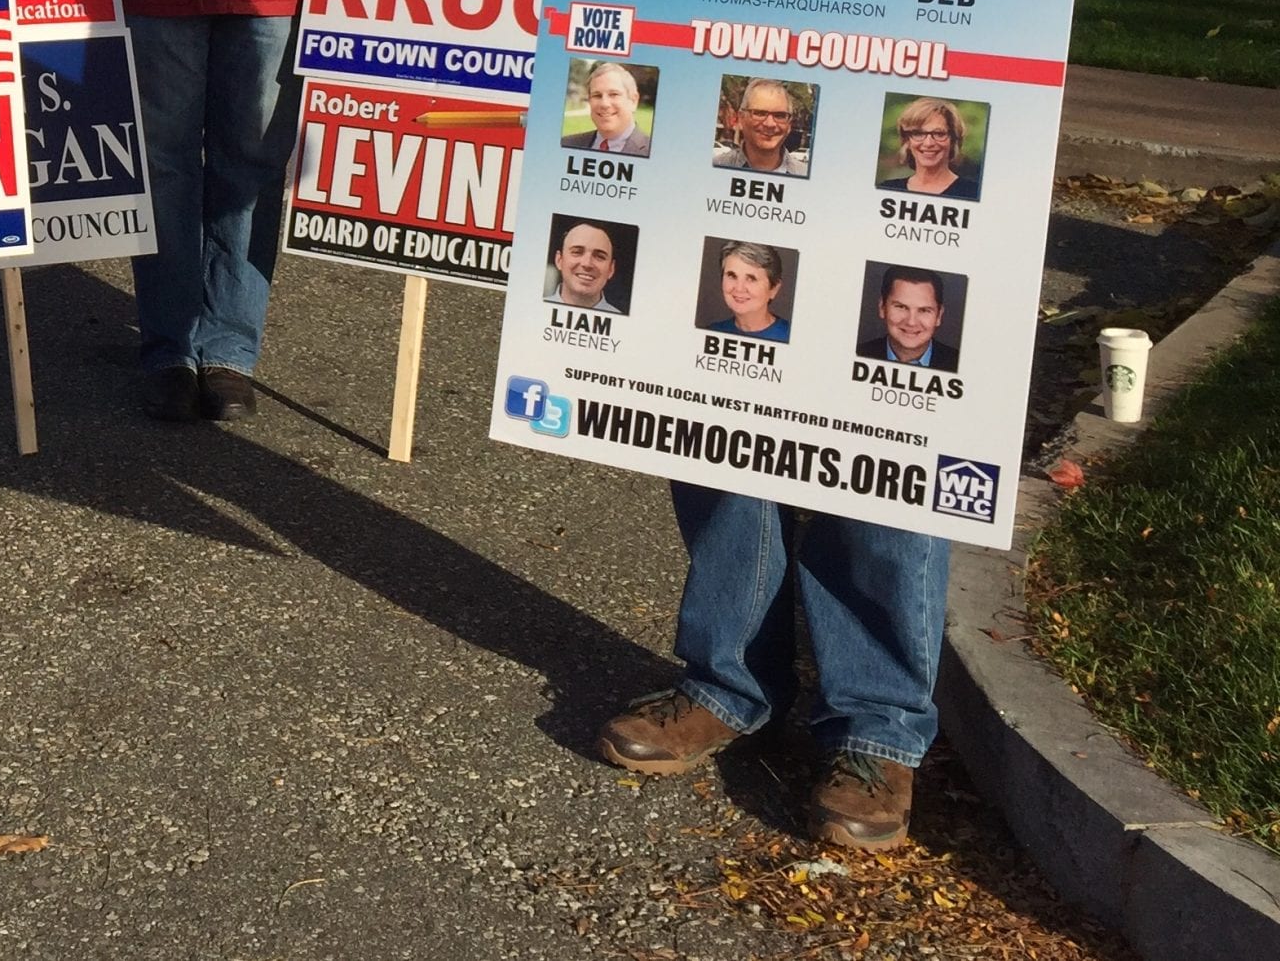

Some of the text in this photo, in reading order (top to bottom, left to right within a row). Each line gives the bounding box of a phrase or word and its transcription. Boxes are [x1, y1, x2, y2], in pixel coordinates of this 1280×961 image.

[582, 7, 622, 30] VOTE
[916, 7, 973, 26] POLUN
[304, 34, 355, 60] FOR
[362, 39, 438, 69] TOWN
[574, 27, 625, 51] ROW A
[690, 19, 949, 79] TOWN COUNCIL
[38, 71, 71, 113] S.
[308, 90, 400, 124] Robert
[566, 155, 634, 182] LEON
[560, 177, 638, 201] DAVIDOFF
[729, 178, 785, 204] BEN
[32, 209, 148, 243] COUNCIL
[706, 197, 807, 226] WENOGRAD
[879, 199, 970, 229] SHARI
[293, 211, 368, 249] BOARD
[372, 225, 400, 255] OF
[884, 223, 960, 248] CANTOR
[550, 309, 612, 336] LIAM
[542, 327, 620, 353] SWEENEY
[703, 335, 776, 365] BETH
[694, 355, 783, 384] KERRIGAN
[851, 362, 964, 400] DALLAS
[565, 367, 929, 448] SUPPORT YOUR LOCAL WEST HARTFORD DEMOCRATS!
[871, 387, 937, 413] DODGE
[577, 398, 927, 506] WHDEMOCRATS.ORG
[939, 471, 993, 500] WH
[939, 491, 992, 515] DTC
